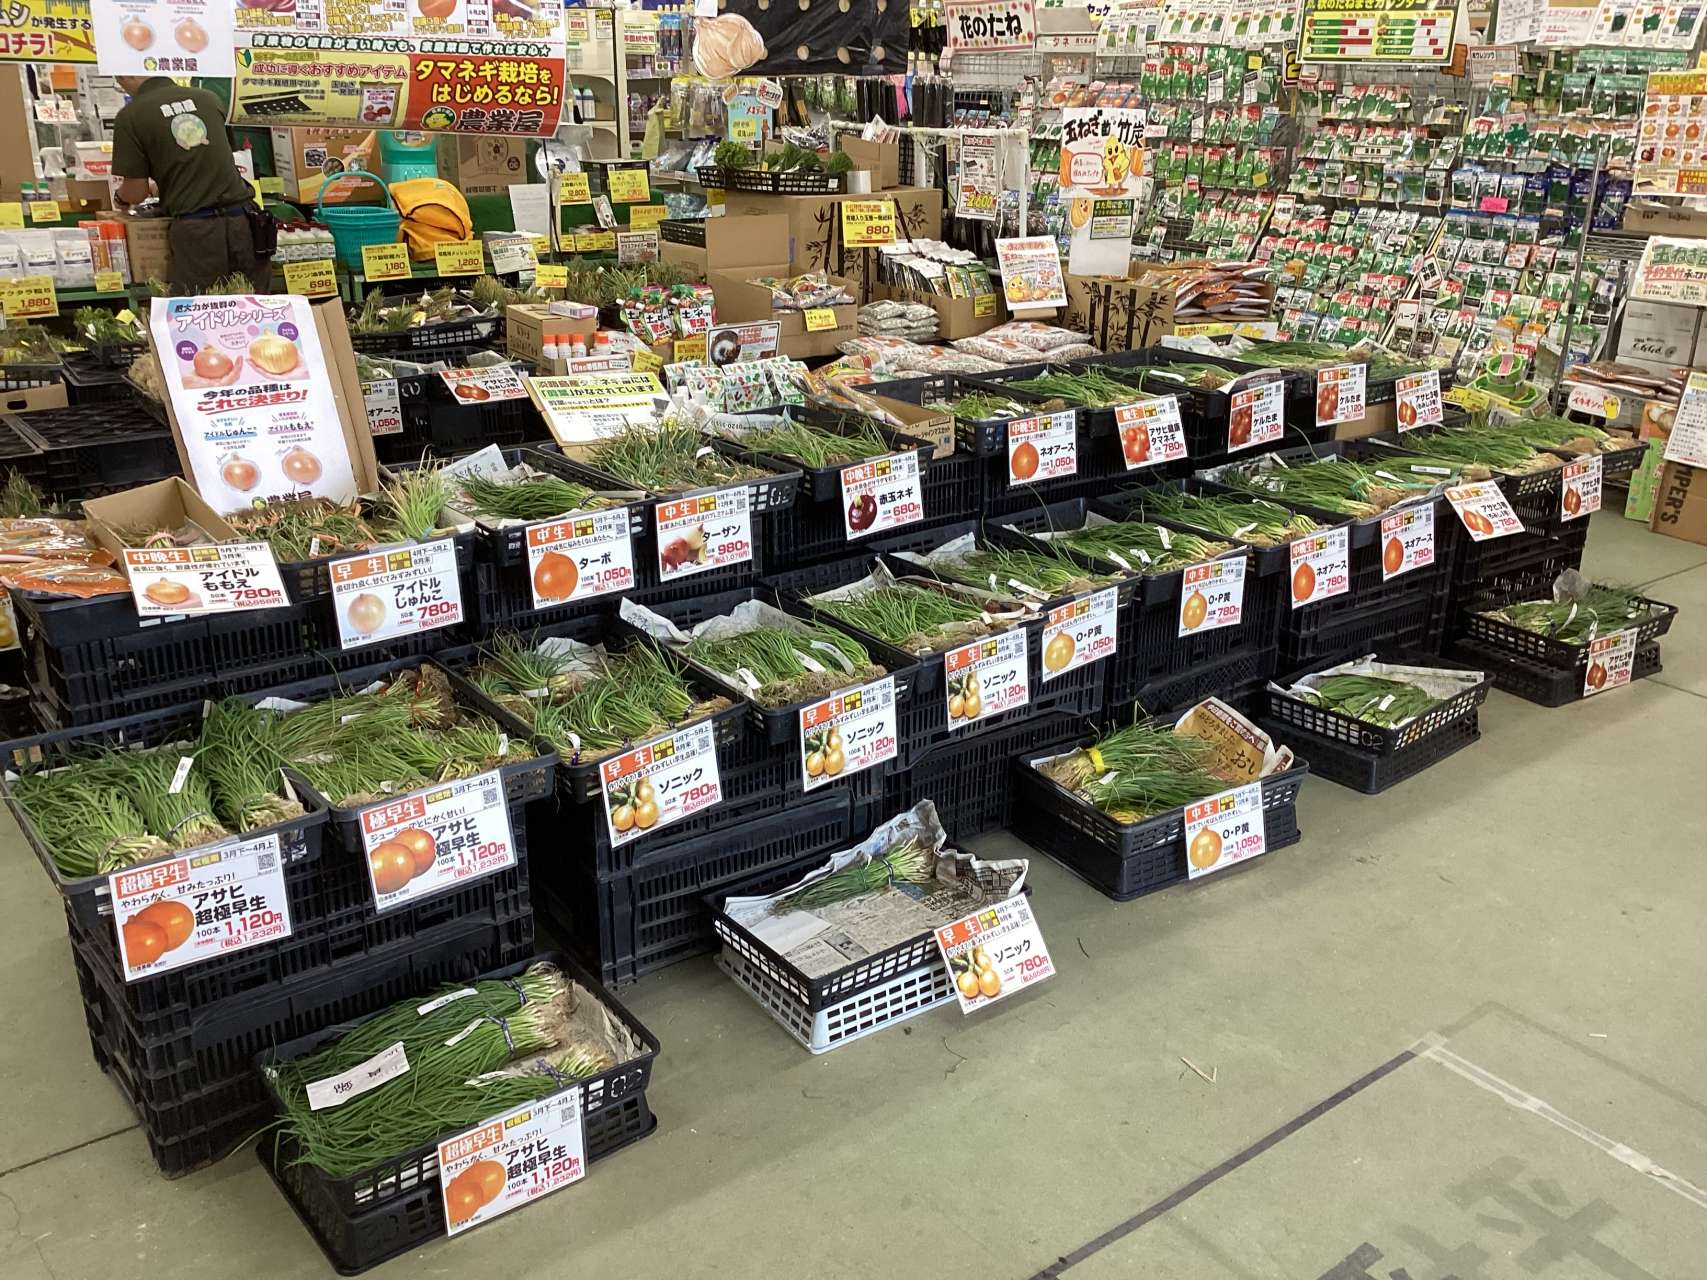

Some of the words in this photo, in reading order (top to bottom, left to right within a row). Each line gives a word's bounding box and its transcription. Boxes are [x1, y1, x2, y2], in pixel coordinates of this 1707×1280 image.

[959, 11, 1023, 39] 花のたね
[158, 57, 198, 72] 農業屋
[416, 60, 552, 85] タマネギ栽培を
[432, 83, 559, 105] はじめるなら!
[456, 109, 544, 133] 農業屋
[1118, 118, 1145, 148] 竹炭
[866, 225, 890, 235] 880
[176, 306, 286, 333] アイドルシリーズ
[197, 390, 308, 412] これで決まり!
[203, 384, 292, 400] 今年の品種は
[1339, 394, 1361, 405] ケルたま
[1254, 413, 1277, 426] ケルたま
[1149, 423, 1181, 437] アサヒ健康
[1040, 442, 1075, 456] ネオアース
[1049, 456, 1074, 469] 1,050円
[847, 466, 873, 483] 中晩生
[879, 487, 914, 505] 赤玉ネギ
[665, 502, 692, 519] 中生
[893, 502, 921, 516] 680円
[537, 525, 567, 543] 中生
[702, 525, 741, 542] ターザン
[1404, 533, 1432, 550] ネオアース
[718, 540, 750, 555] 980円
[132, 551, 187, 564] 中晩生
[579, 552, 612, 570] ターボ
[200, 568, 259, 581] アイドル
[337, 558, 384, 579] 早生
[596, 566, 632, 584] 1,050円
[1189, 567, 1206, 582] 中生
[1317, 560, 1347, 577] ネオアース
[203, 579, 251, 590] ももえ
[230, 587, 281, 599] 780円
[393, 577, 441, 597] アイドル
[395, 589, 443, 610] じゅんこ
[417, 602, 458, 619] 780円
[1048, 605, 1070, 622] 中生
[1217, 605, 1240, 617] 780円
[1086, 636, 1114, 653] 1,050円
[950, 646, 981, 668] 早生
[984, 670, 1017, 689] ソニック
[995, 684, 1026, 701] 1,120円
[807, 700, 840, 724] 早生
[847, 722, 884, 744] ソニック
[862, 737, 895, 756] 1,120円
[609, 750, 649, 777] 早生
[659, 768, 703, 794] ソニック
[680, 784, 718, 805] 780円
[369, 798, 422, 831] 極早生
[1192, 802, 1214, 818] 中生
[433, 818, 477, 841] アサヒ
[435, 832, 482, 857] 極早生
[1235, 834, 1263, 851] 1,050円
[437, 857, 456, 867] 100本
[457, 842, 506, 867] 1,120円
[120, 863, 189, 894] 超極早生
[223, 841, 275, 859] 3月下~4月上
[454, 855, 509, 879] (税込1,232円)
[193, 885, 245, 909] アサヒ
[195, 896, 267, 927] 超極早生
[196, 927, 221, 938] 100本
[225, 911, 283, 937] 1,120円
[942, 919, 980, 944] 早生
[220, 925, 286, 949] (税込1,232円)
[994, 939, 1031, 964] ソニック
[1016, 955, 1050, 976] 780円
[445, 1124, 500, 1163] 超極早生
[506, 1138, 550, 1166] アサヒ
[507, 1145, 567, 1181] 超極早生
[508, 1179, 528, 1191] 100本
[531, 1158, 580, 1185] 1,120円
